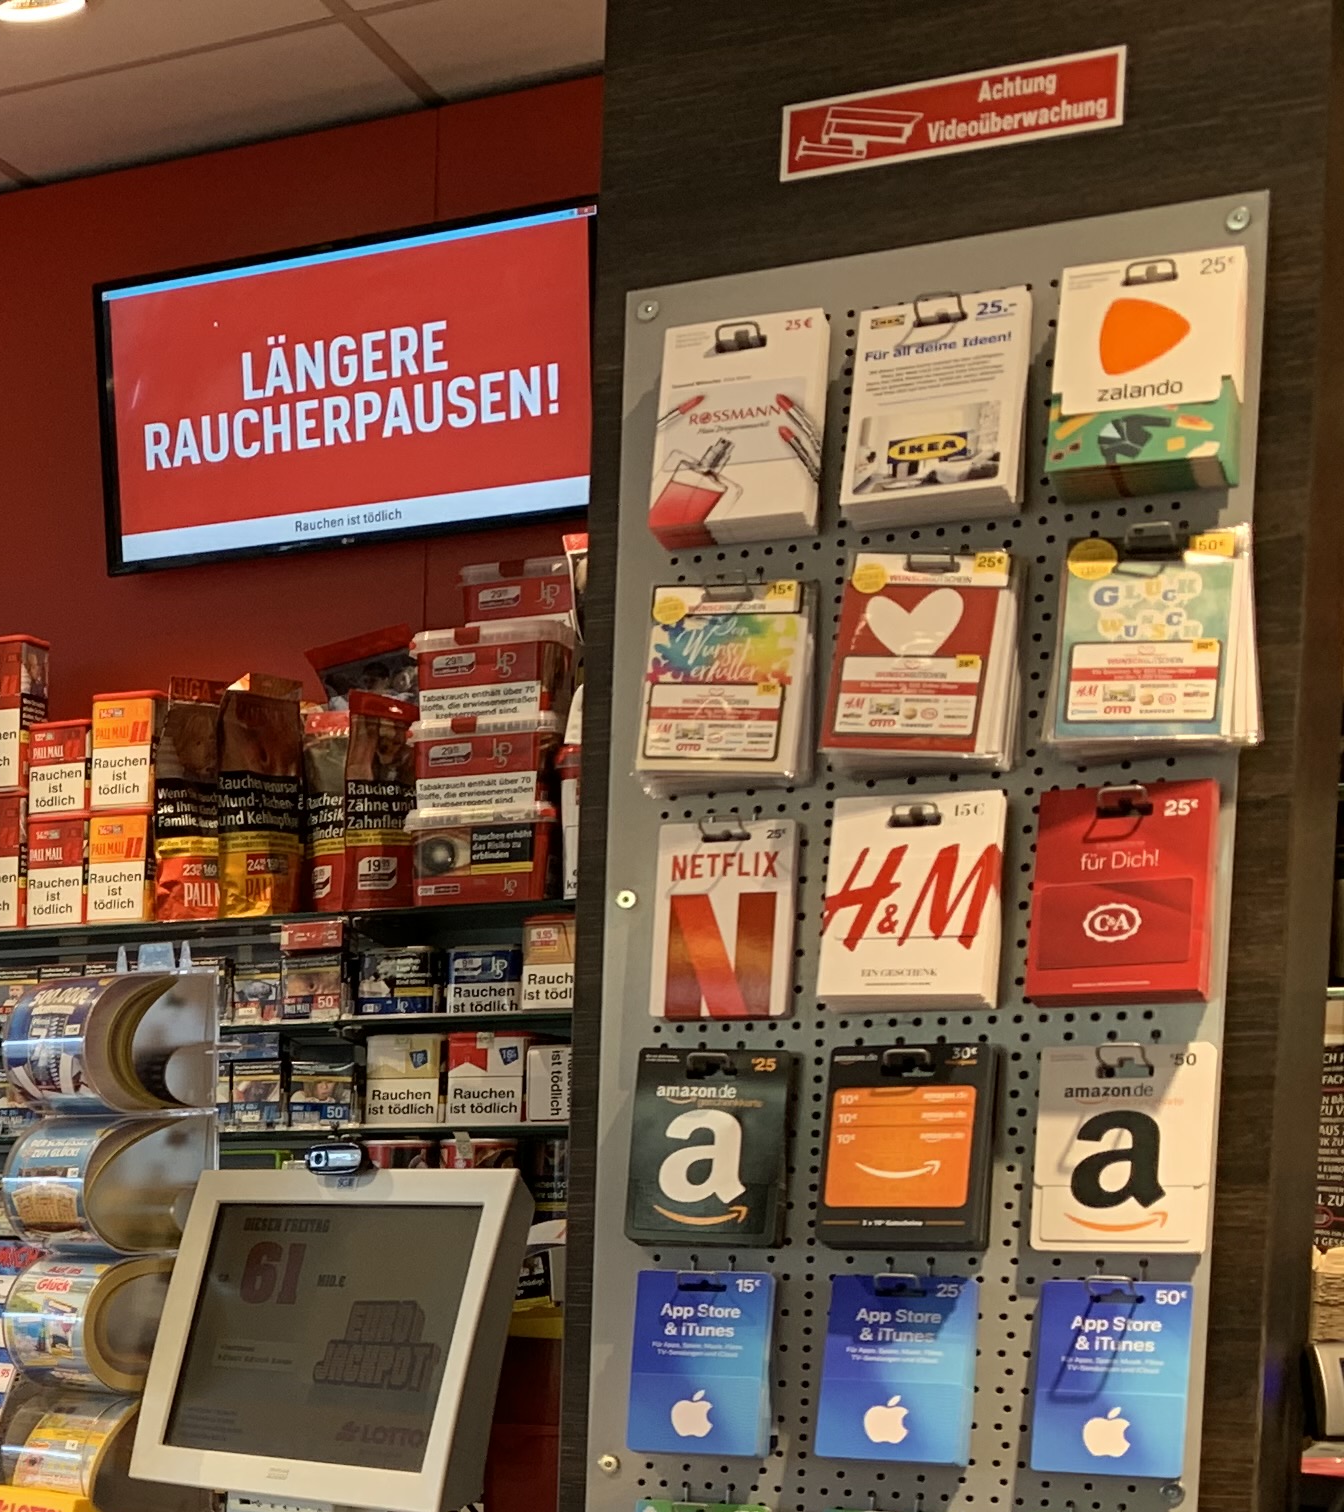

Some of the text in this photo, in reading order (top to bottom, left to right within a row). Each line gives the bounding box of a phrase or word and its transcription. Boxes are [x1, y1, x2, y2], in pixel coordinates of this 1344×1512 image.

[977, 71, 1057, 103] Achtung
[926, 97, 1108, 144] Videoüberwachung
[865, 330, 1013, 363] Für all deine Ideen!
[241, 320, 448, 400] LÄNGERE
[1097, 378, 1183, 404] zalando
[144, 363, 560, 470] RAUCHERPAUSEN!
[688, 403, 781, 426] ROSSMANN
[897, 437, 959, 456] IKEA
[295, 507, 402, 533] Rauchen ist tödlich
[92, 755, 147, 772] Rauchen
[112, 770, 126, 782] ist
[97, 782, 141, 796] tödlich
[672, 851, 779, 880] NETFLIX
[1080, 848, 1159, 870] für Dich!
[822, 842, 1002, 951] H&M
[453, 1087, 512, 1101] Rauchen
[657, 1084, 737, 1101] amazon.de
[1064, 1083, 1153, 1099] amazon.de
[448, 1100, 518, 1115] ist tödlich
[661, 1303, 740, 1321] App Store
[856, 1308, 941, 1326] App Store
[665, 1323, 734, 1338] & iTunes
[1071, 1315, 1162, 1334] App Store
[859, 1328, 935, 1345] & iTunes
[1076, 1335, 1155, 1354] & iTunes
